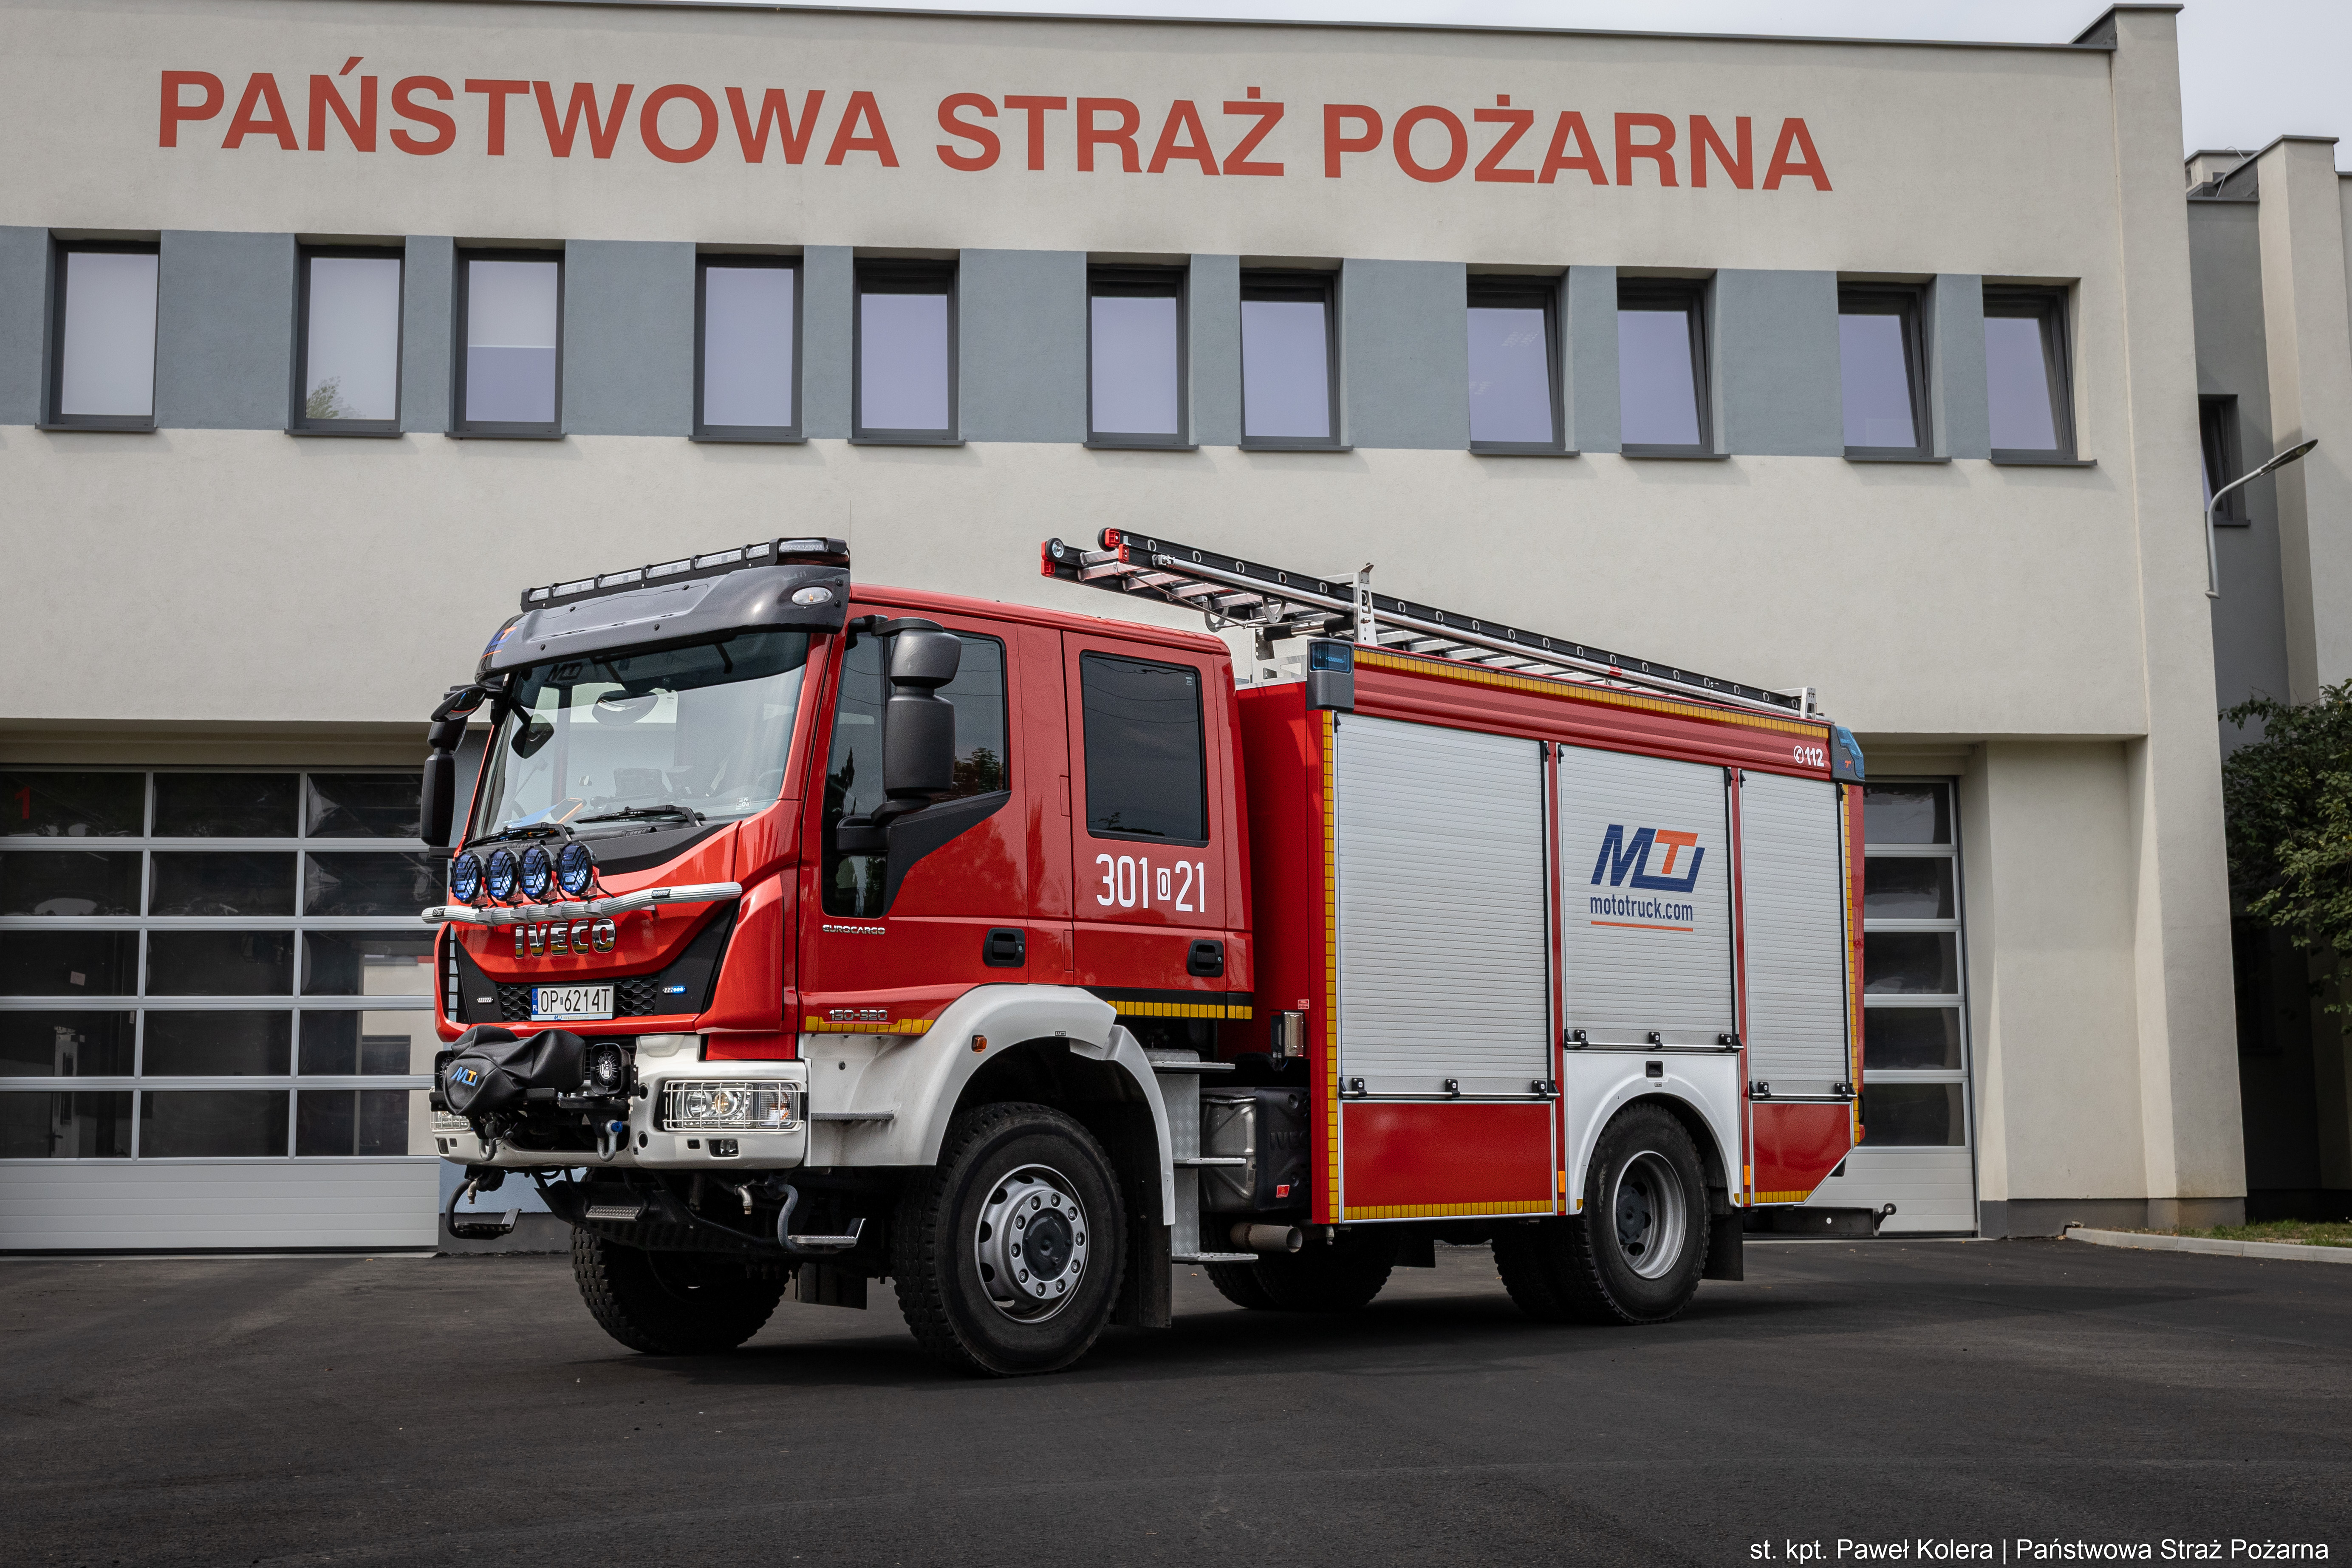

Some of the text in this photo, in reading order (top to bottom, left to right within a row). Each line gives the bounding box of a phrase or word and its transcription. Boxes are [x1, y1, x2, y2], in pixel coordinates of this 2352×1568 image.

[160, 57, 1832, 191] PAŃSTWOWA STRAŻ POŻARNA
[1805, 746, 1824, 767] 112
[15, 786, 30, 819] 1
[1096, 853, 1148, 909] 301
[1175, 860, 1205, 913] 21
[1590, 894, 1693, 921] mototruck.com
[515, 918, 616, 959] IVECO
[823, 924, 885, 935] EUROCARGO
[541, 989, 611, 1012] OP 6214T
[829, 1009, 888, 1021] 150-320
